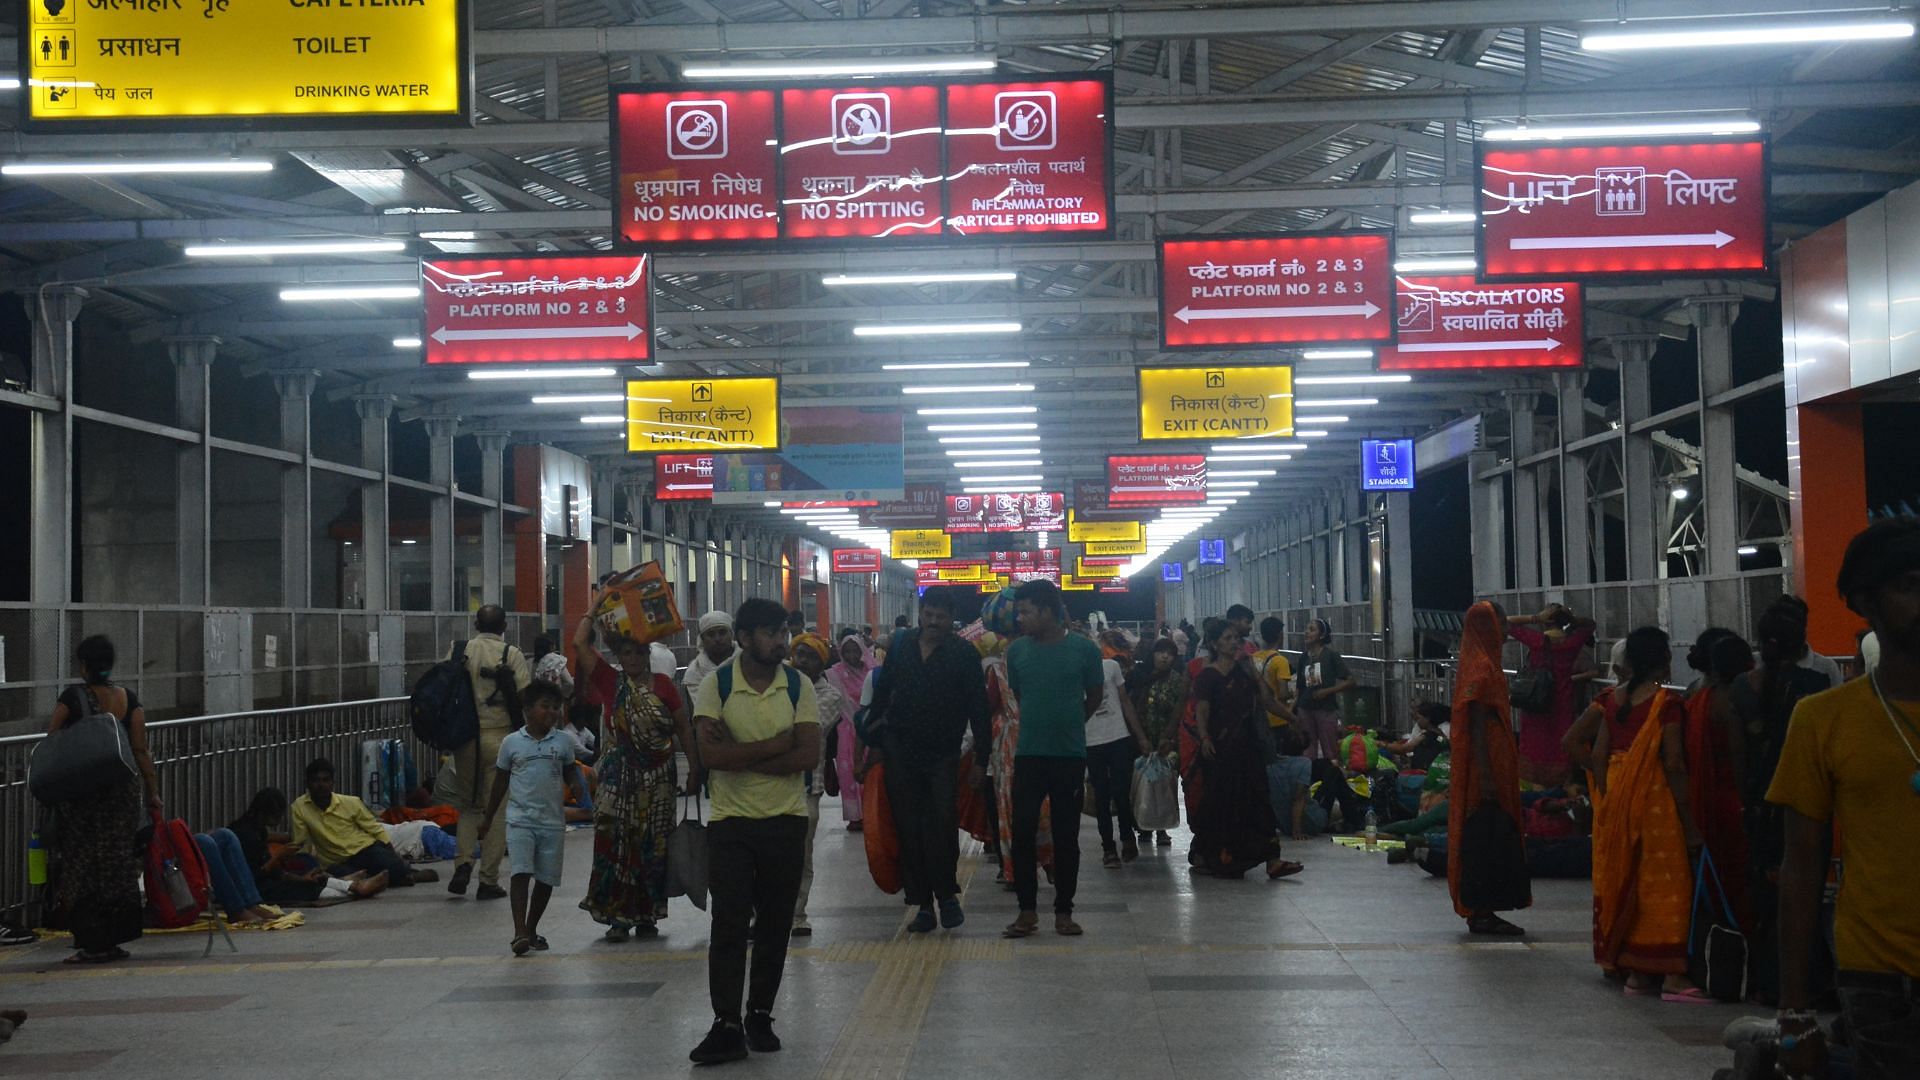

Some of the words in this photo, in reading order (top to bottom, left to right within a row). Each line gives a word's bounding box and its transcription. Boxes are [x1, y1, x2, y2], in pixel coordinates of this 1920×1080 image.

[97, 38, 181, 57] प्रसाधन
[293, 36, 371, 54] TOILET
[93, 83, 115, 101] पेय
[125, 87, 153, 101] जल
[295, 85, 370, 97] DRINKING
[375, 84, 429, 96] WATER
[1049, 156, 1086, 174] पदार्थ
[634, 178, 700, 203] धूम्रपान
[712, 172, 763, 195] निषेध
[1508, 180, 1575, 206] LIFT
[1664, 169, 1737, 206] लिफ्ट
[634, 205, 664, 221] NO
[669, 203, 764, 220] SMOKING
[801, 202, 831, 219] NO
[835, 201, 925, 218] SPITTING
[972, 197, 1083, 211] INFLAMMATORY
[958, 214, 1014, 227] ARTICLE
[1017, 212, 1099, 225] PROHIBITED
[1188, 261, 1229, 279] प्लेट
[1232, 258, 1276, 278] फार्म
[1316, 259, 1328, 273] 2
[1333, 259, 1347, 272] &
[1353, 258, 1364, 272] 3
[1192, 284, 1280, 298] PLATFORM
[1286, 283, 1310, 296] NO
[1318, 283, 1327, 294] 2
[1334, 281, 1347, 294] &
[1354, 282, 1364, 293] 3
[1439, 288, 1564, 307] ESCALATORS
[449, 302, 540, 317] PLATFORM
[546, 302, 571, 315] NO
[579, 302, 588, 314] 2
[596, 301, 608, 313] &
[615, 300, 625, 313] 3
[1442, 309, 1520, 331] स्वचालित
[1164, 419, 1199, 431] EXIT
[1203, 417, 1269, 432] (CANTT)
[651, 431, 686, 444] EXIT
[690, 430, 754, 444] (CANTT)
[664, 463, 690, 474] LIFT
[1368, 477, 1409, 486] STAIRCASE
